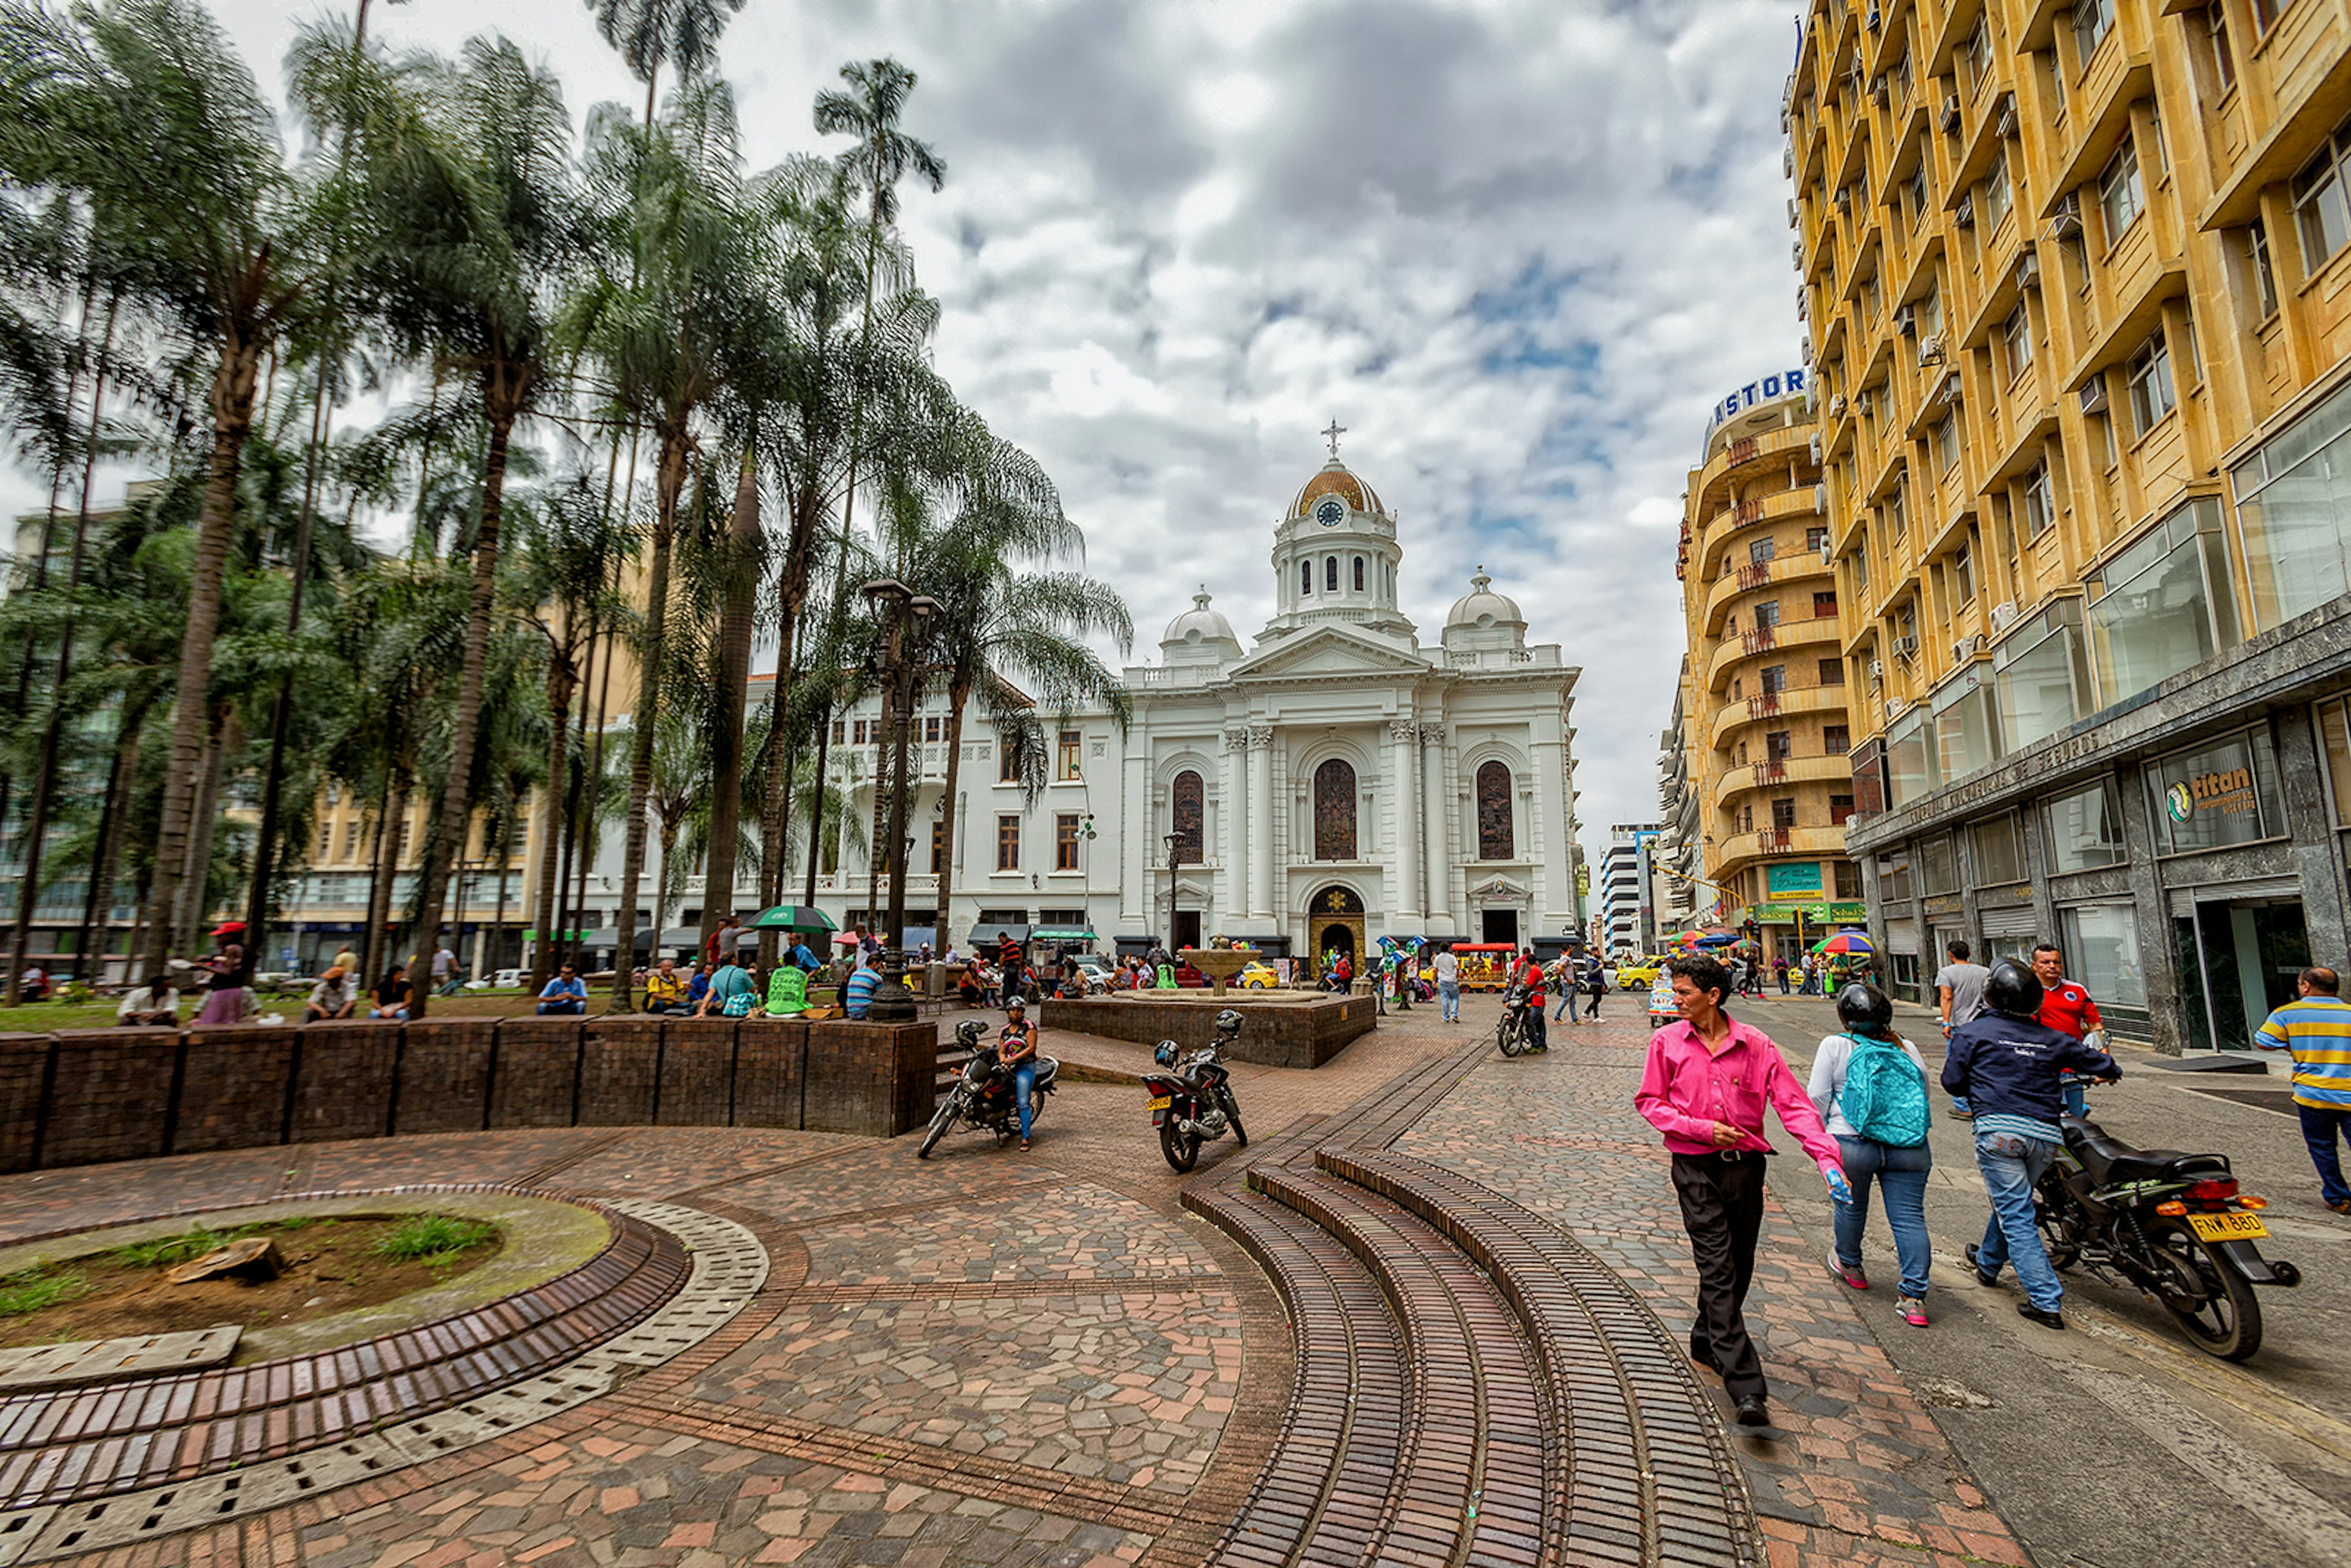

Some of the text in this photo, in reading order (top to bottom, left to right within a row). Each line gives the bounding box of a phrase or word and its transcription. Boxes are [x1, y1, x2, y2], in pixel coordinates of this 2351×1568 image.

[2038, 732, 2099, 770] SEGUROS
[2191, 767, 2250, 799] titan
[1832, 908, 1857, 917] Salud
